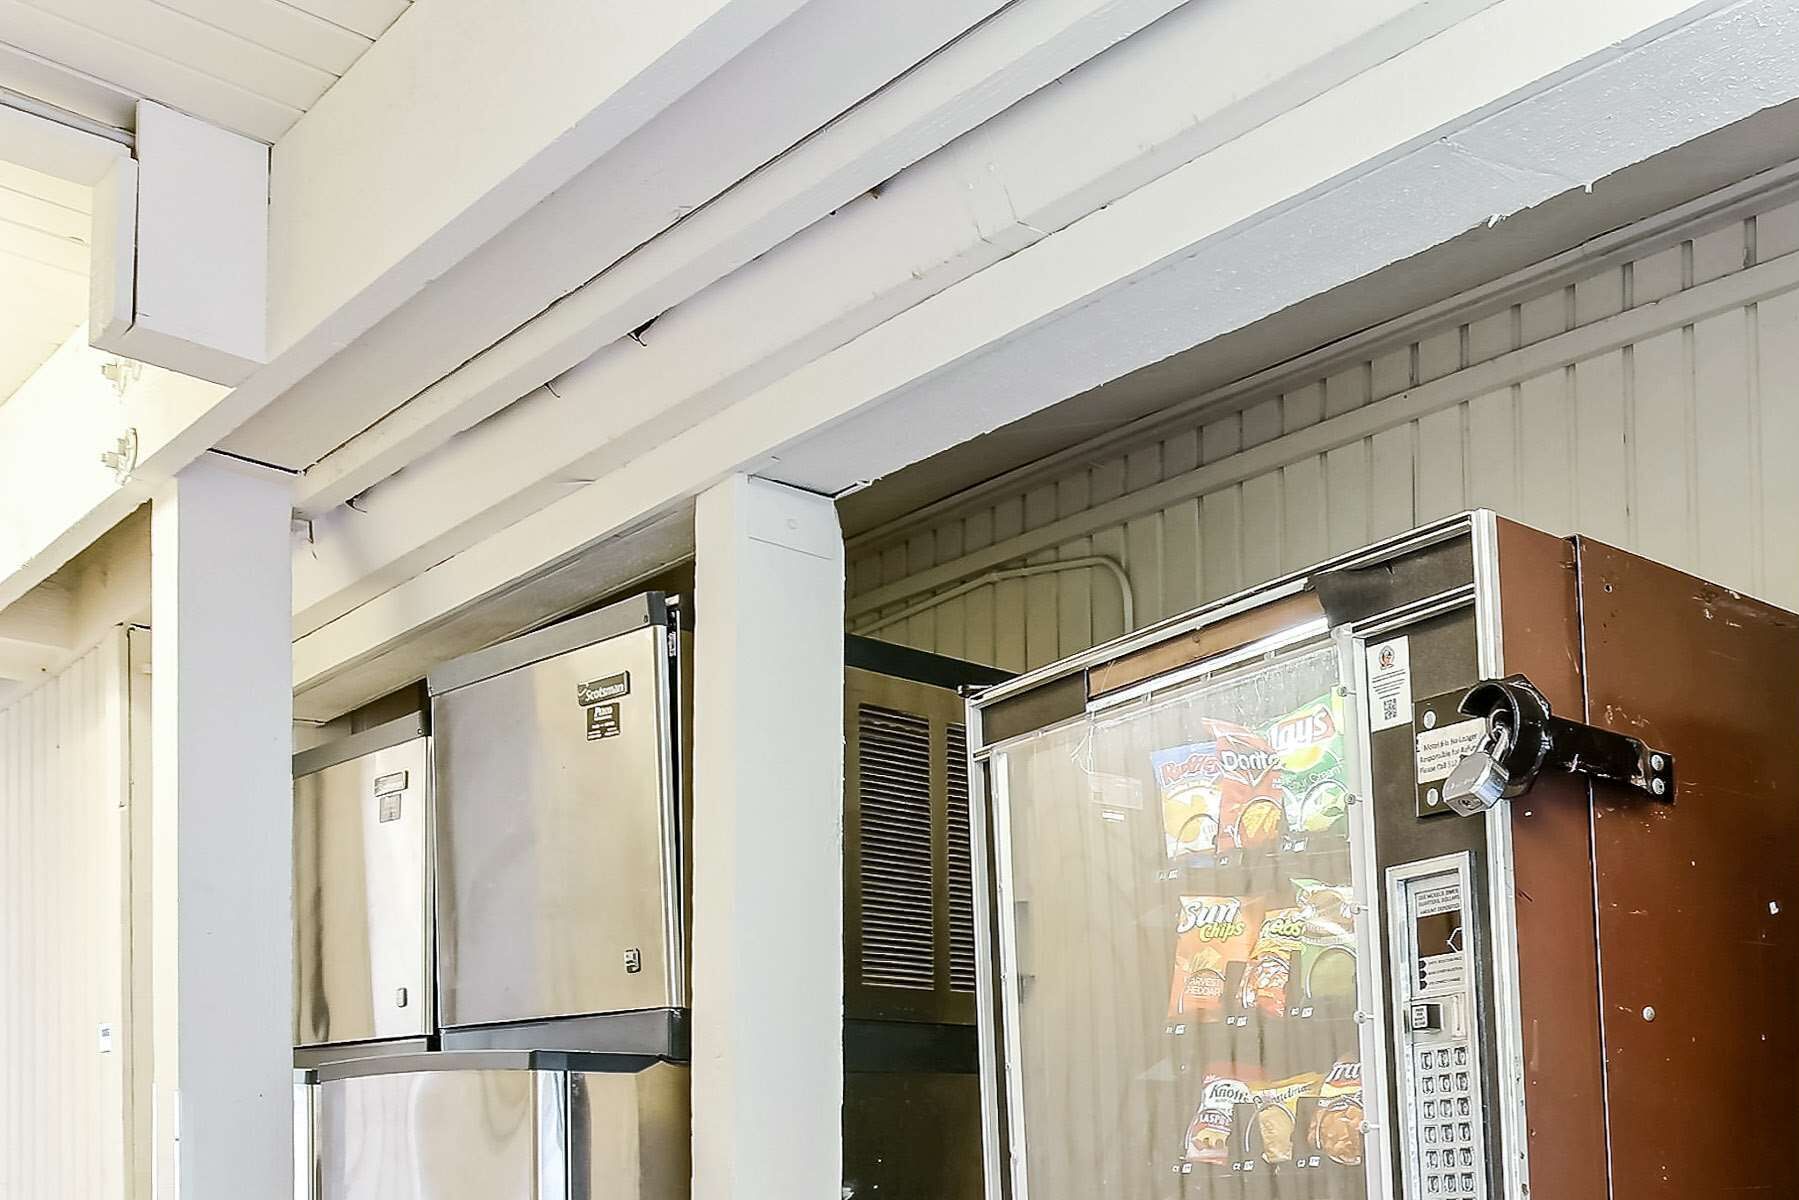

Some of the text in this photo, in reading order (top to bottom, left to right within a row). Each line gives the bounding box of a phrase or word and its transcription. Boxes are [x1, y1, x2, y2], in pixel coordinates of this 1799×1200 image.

[585, 683, 624, 701] Scotsman
[1222, 751, 1281, 771] Dorito
[1176, 902, 1240, 933] Sun
